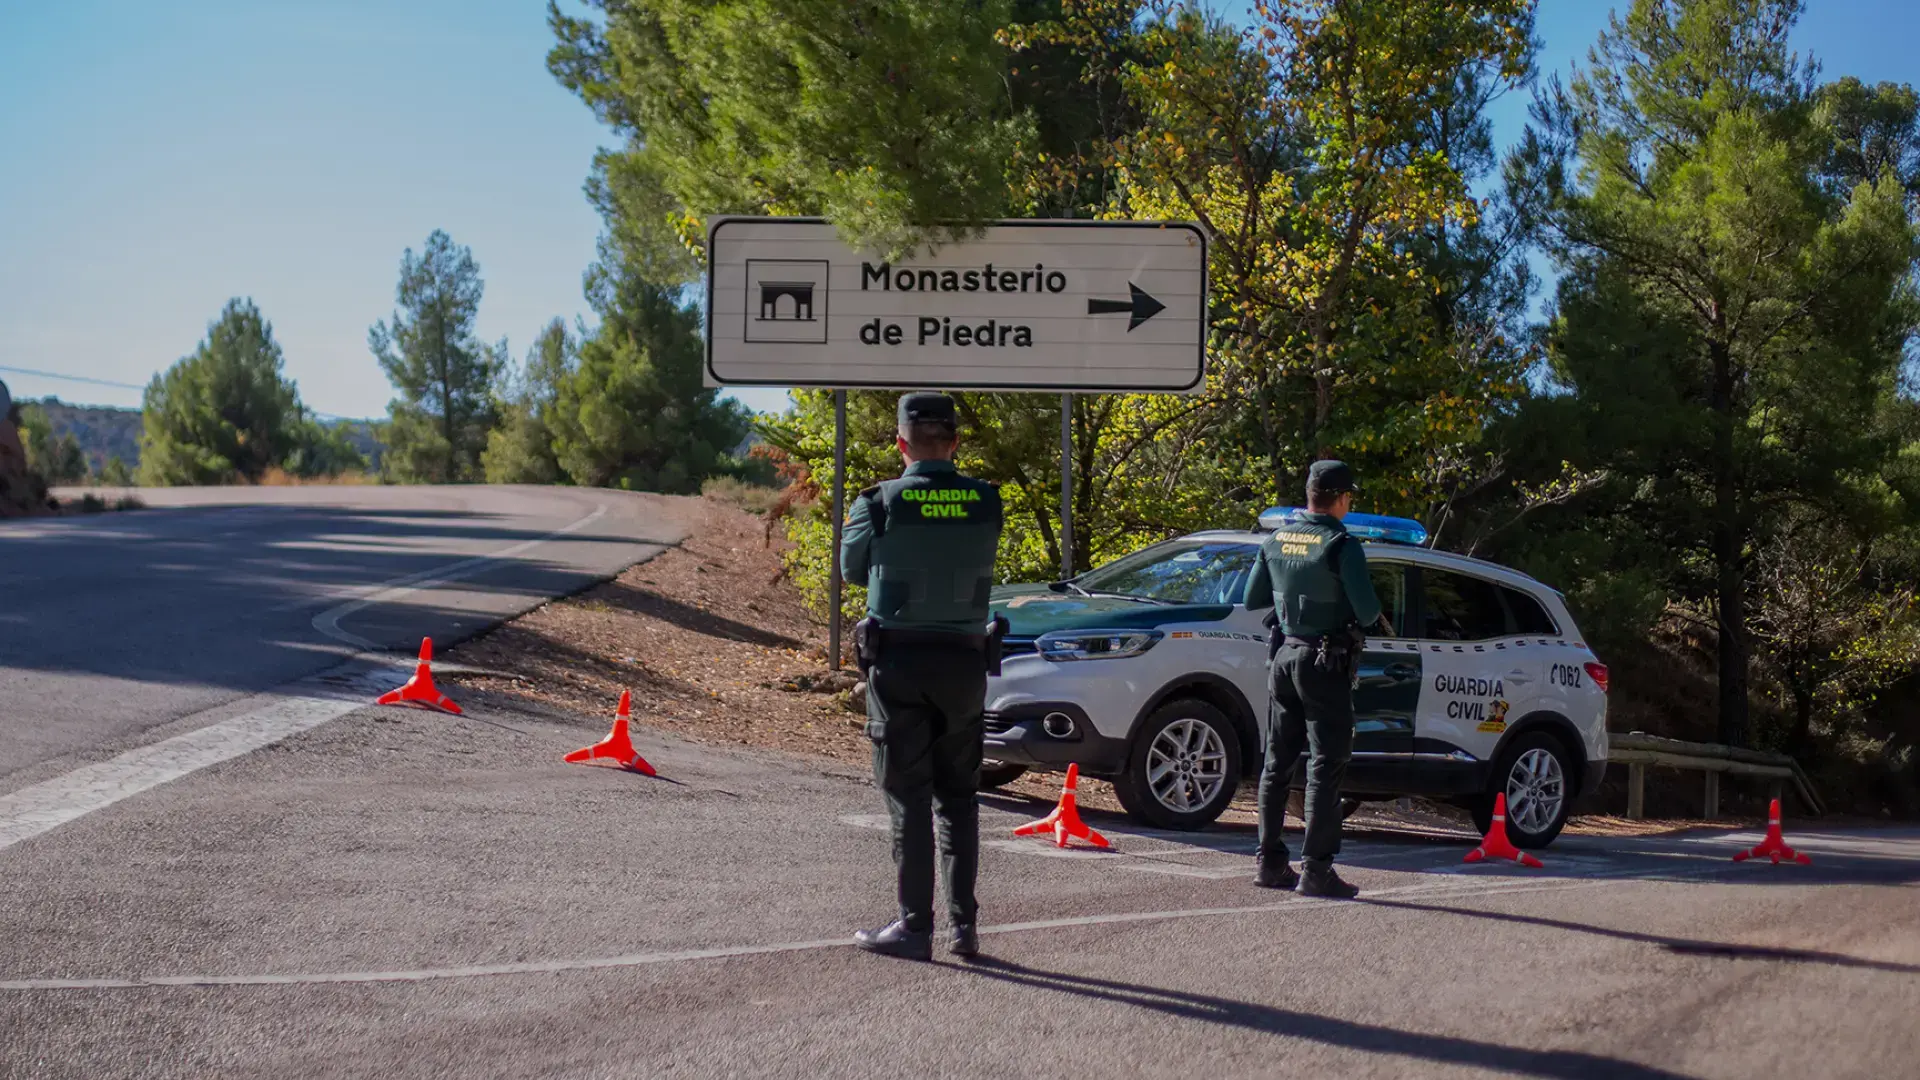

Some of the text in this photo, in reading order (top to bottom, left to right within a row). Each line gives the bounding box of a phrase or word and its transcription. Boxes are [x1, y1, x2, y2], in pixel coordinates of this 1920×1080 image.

[861, 262, 1067, 293] Monasterio
[859, 316, 1033, 347] de Piedra
[901, 488, 981, 502] GUARDIA
[921, 503, 969, 518] CIVIL
[1275, 531, 1323, 545] GUARDIA
[1281, 543, 1309, 556] CIVIL
[1434, 674, 1504, 698] GUARDIA
[1558, 663, 1581, 689] 062
[1446, 700, 1485, 721] CIVIL
